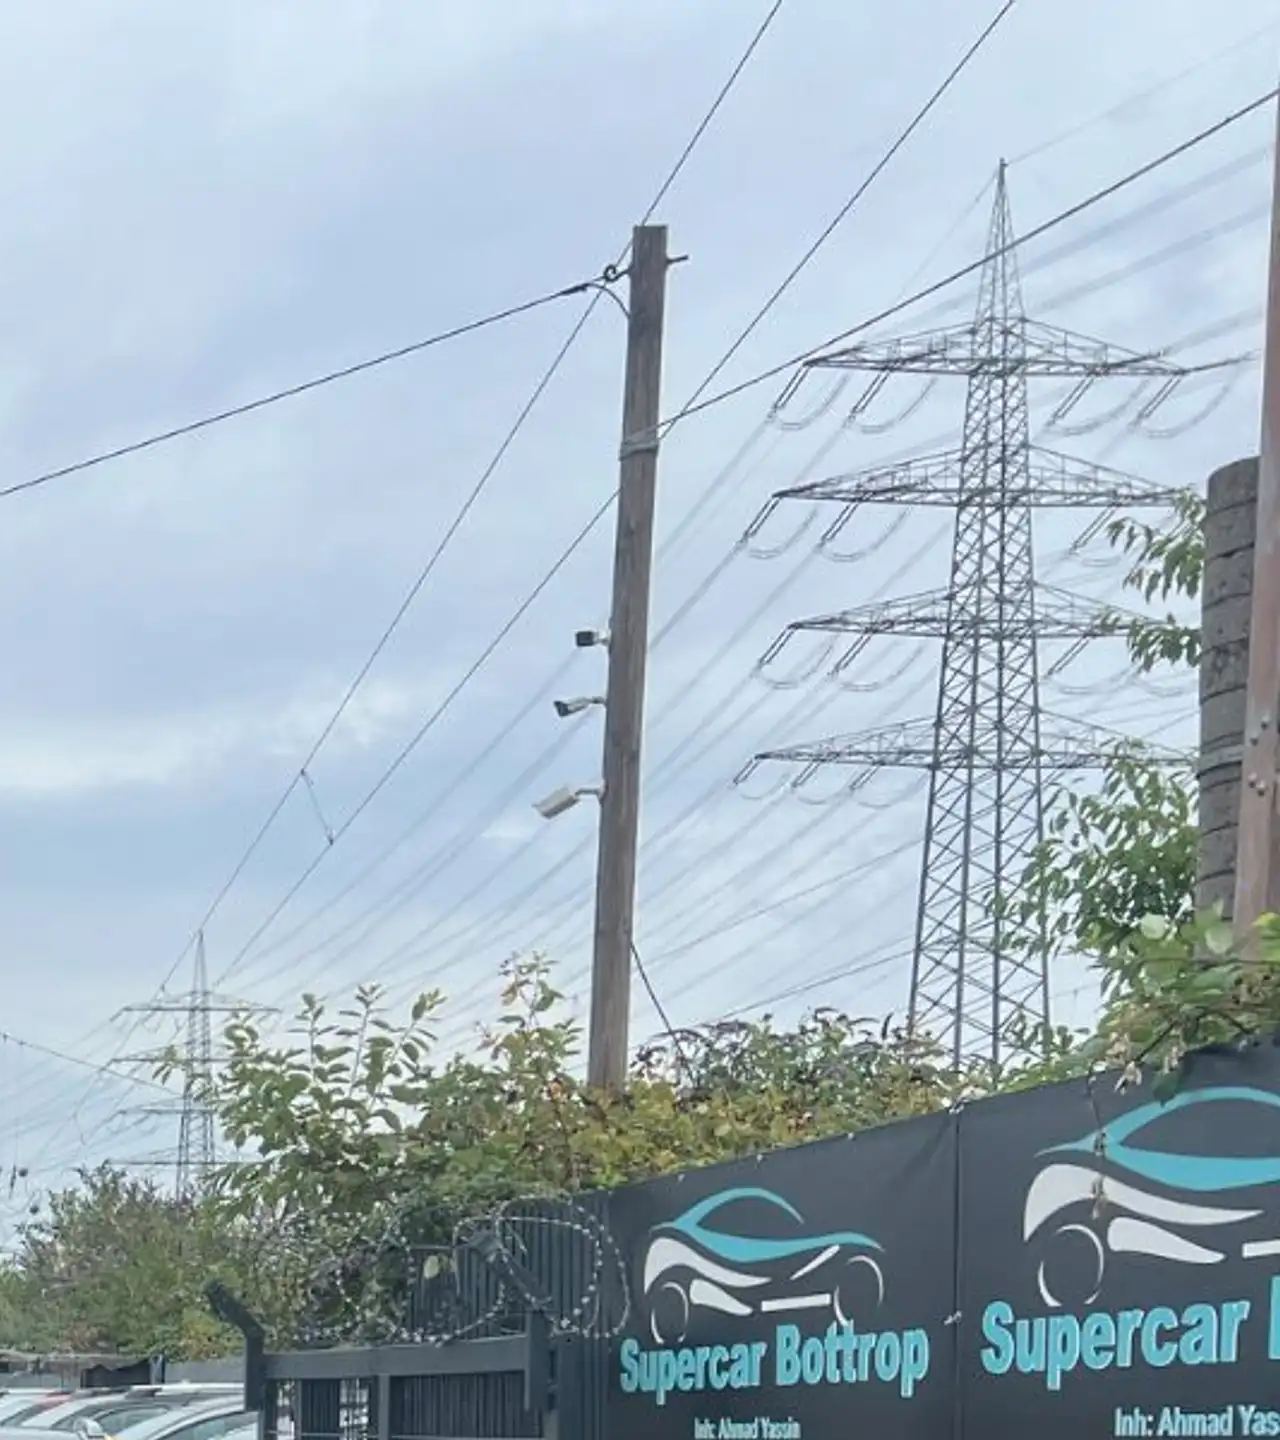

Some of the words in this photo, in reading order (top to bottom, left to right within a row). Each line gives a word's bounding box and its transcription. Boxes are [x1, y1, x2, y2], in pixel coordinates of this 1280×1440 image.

[619, 1338, 767, 1405] Supercar
[775, 1319, 930, 1398] Bottrop
[980, 1300, 1251, 1391] Supercar
[718, 1417, 758, 1440] Ahmad
[760, 1416, 801, 1440] Yassin
[1114, 1407, 1154, 1438] Inh:
[1157, 1405, 1234, 1438] Ahmad
